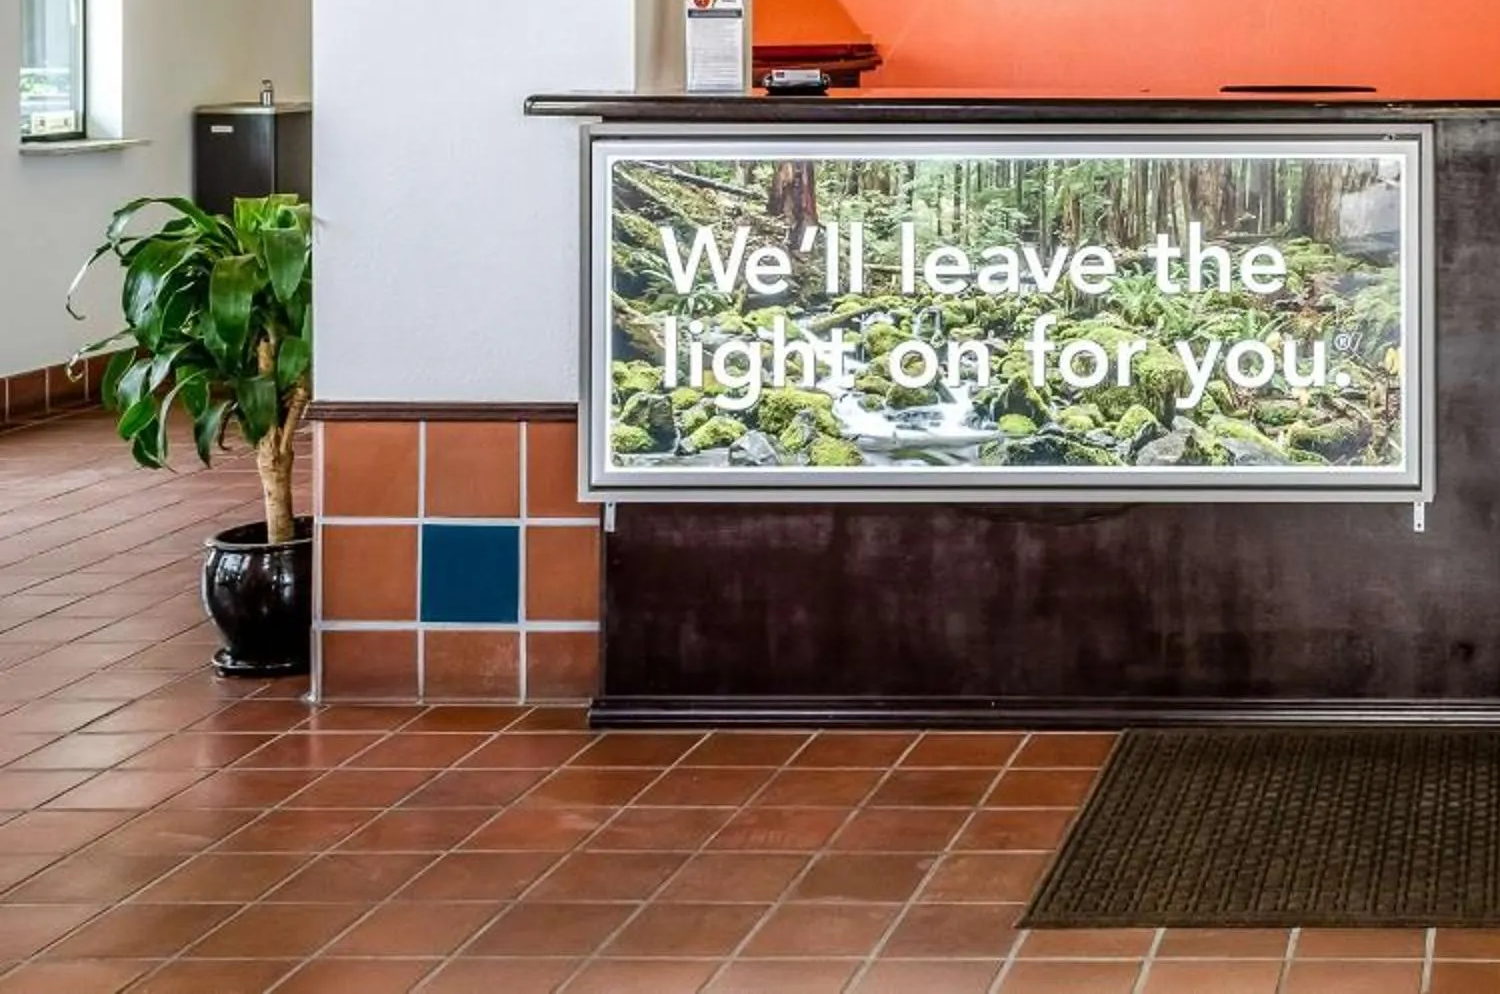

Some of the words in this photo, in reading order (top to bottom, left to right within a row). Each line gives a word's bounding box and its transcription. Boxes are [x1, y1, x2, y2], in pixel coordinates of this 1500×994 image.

[659, 221, 863, 295] We'll
[900, 221, 1117, 295] leave
[1147, 221, 1288, 295] the
[663, 314, 856, 410] light
[888, 339, 992, 389] on
[1023, 313, 1147, 388] for
